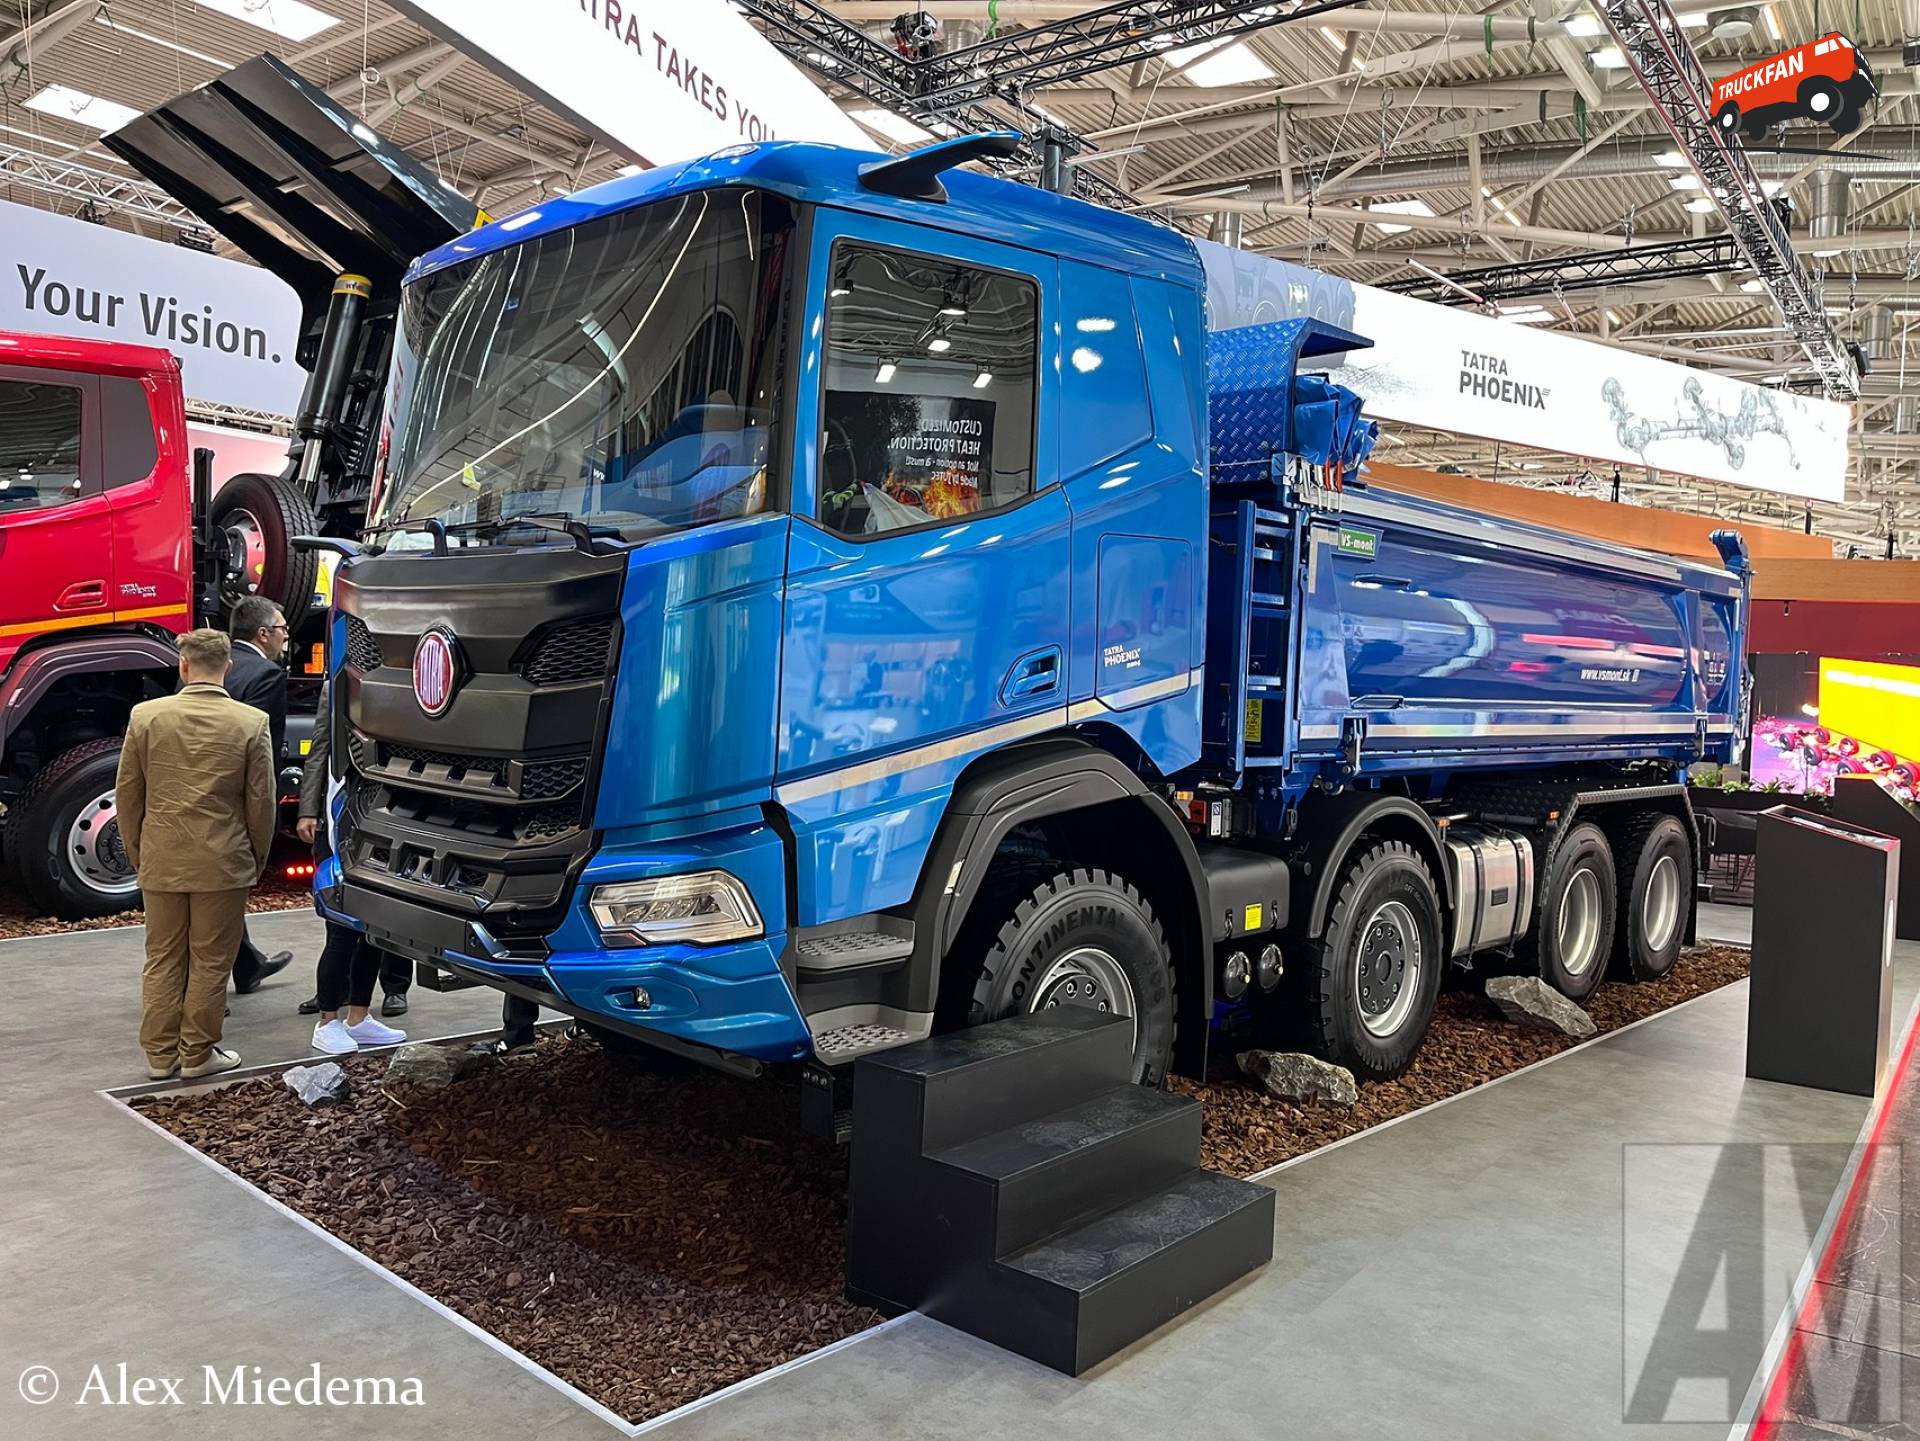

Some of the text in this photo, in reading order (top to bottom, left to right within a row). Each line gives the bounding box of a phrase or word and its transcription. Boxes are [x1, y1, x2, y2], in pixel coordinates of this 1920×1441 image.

[580, 0, 642, 56] RA
[653, 31, 727, 121] TAKES
[16, 263, 281, 364] Your Vision.
[1461, 349, 1508, 376] TATRA
[1459, 370, 1545, 410] PHOENIX
[1341, 534, 1373, 551] VS-mont
[1581, 669, 1631, 682] www.vsmont.sk
